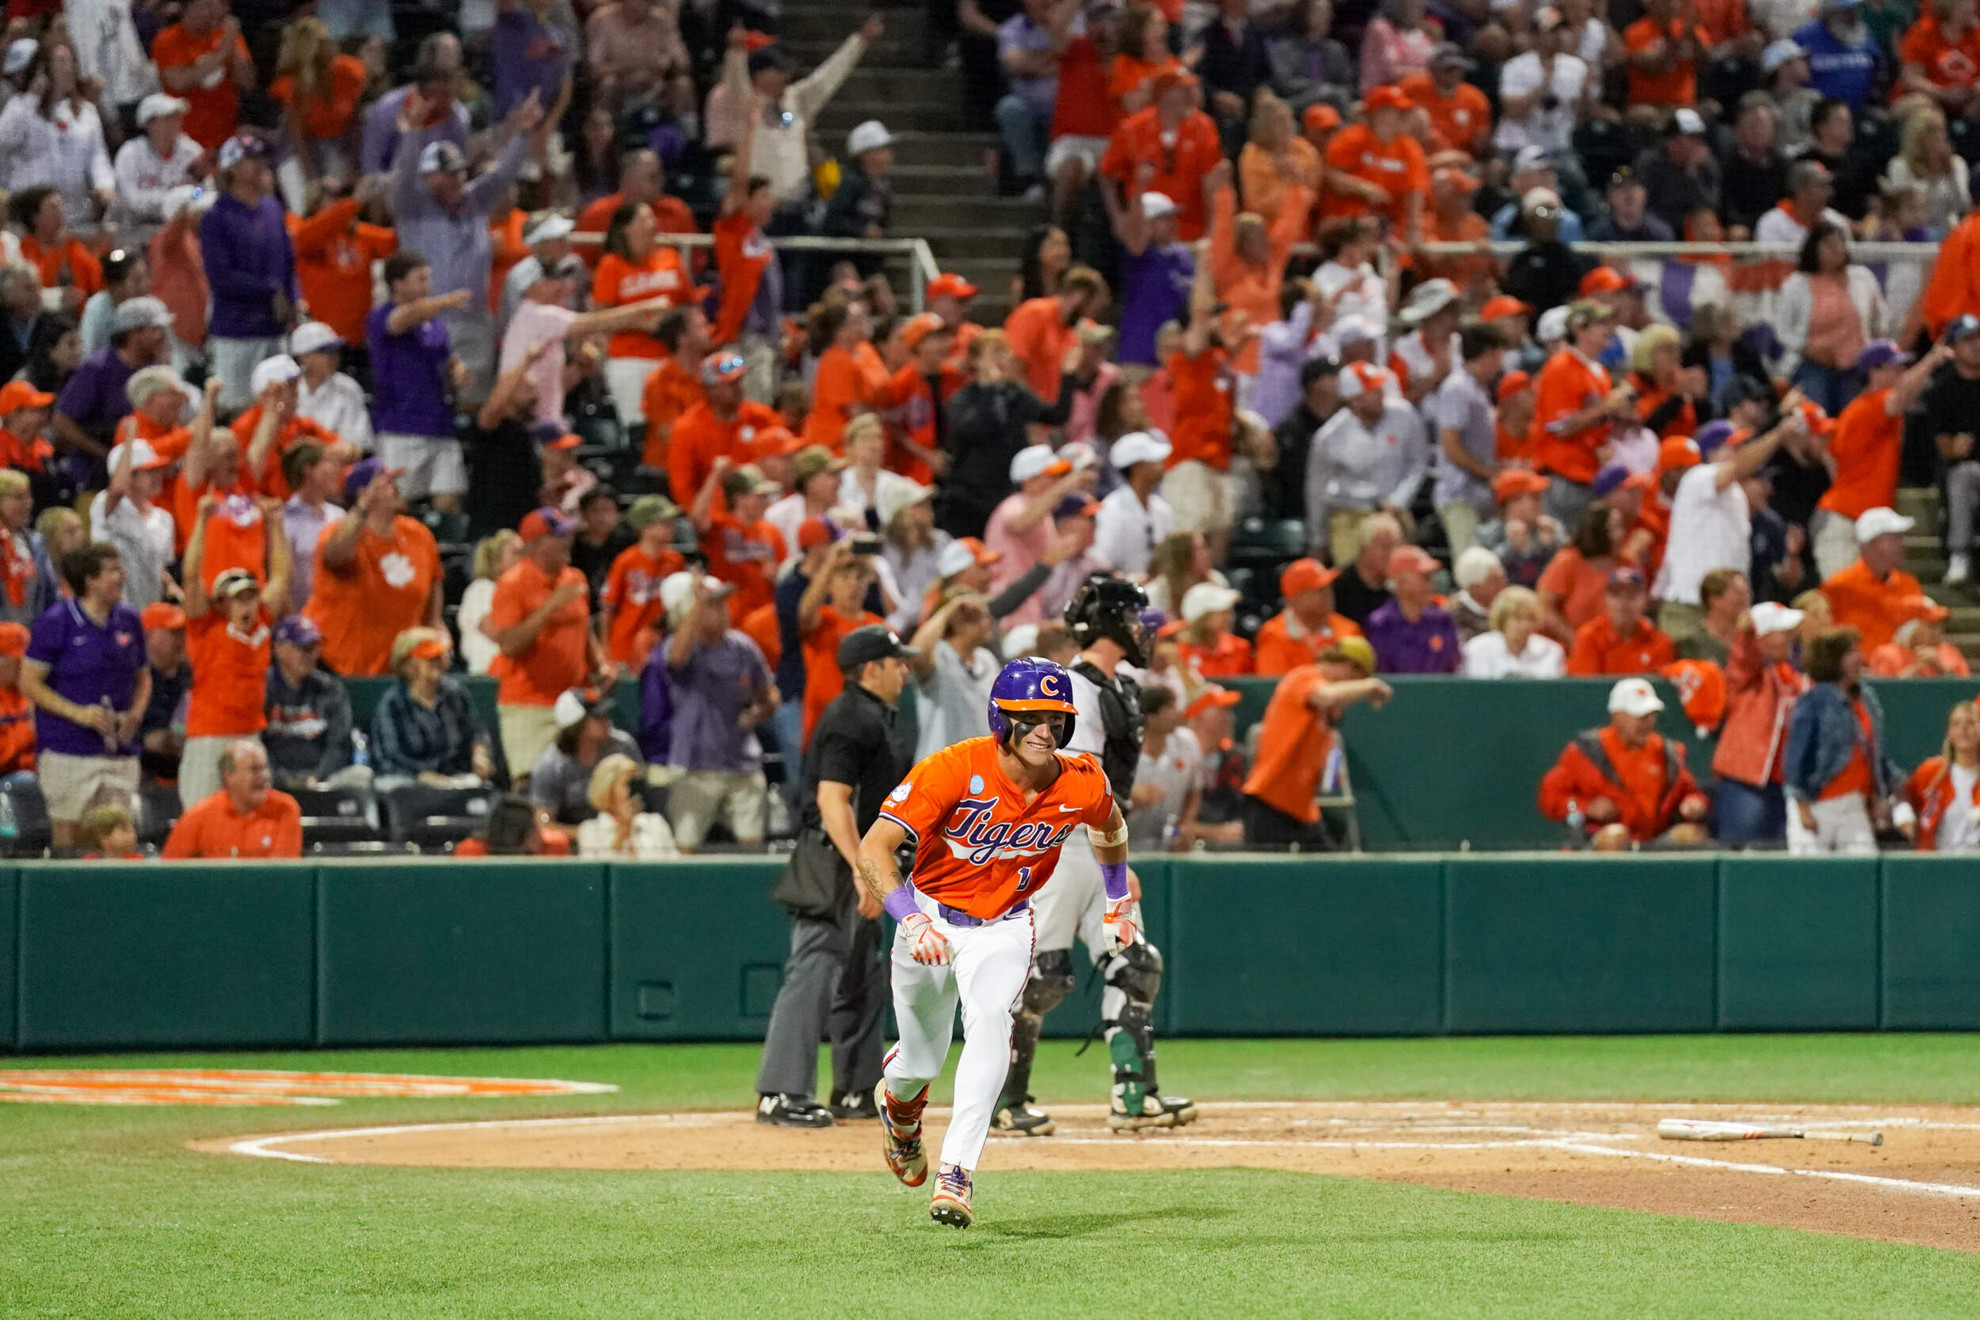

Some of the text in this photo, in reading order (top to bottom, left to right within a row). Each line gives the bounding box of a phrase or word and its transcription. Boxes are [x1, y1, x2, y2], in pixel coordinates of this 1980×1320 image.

[1040, 675, 1059, 697] C
[944, 796, 1072, 866] Tigers
[1017, 866, 1031, 891] 1
